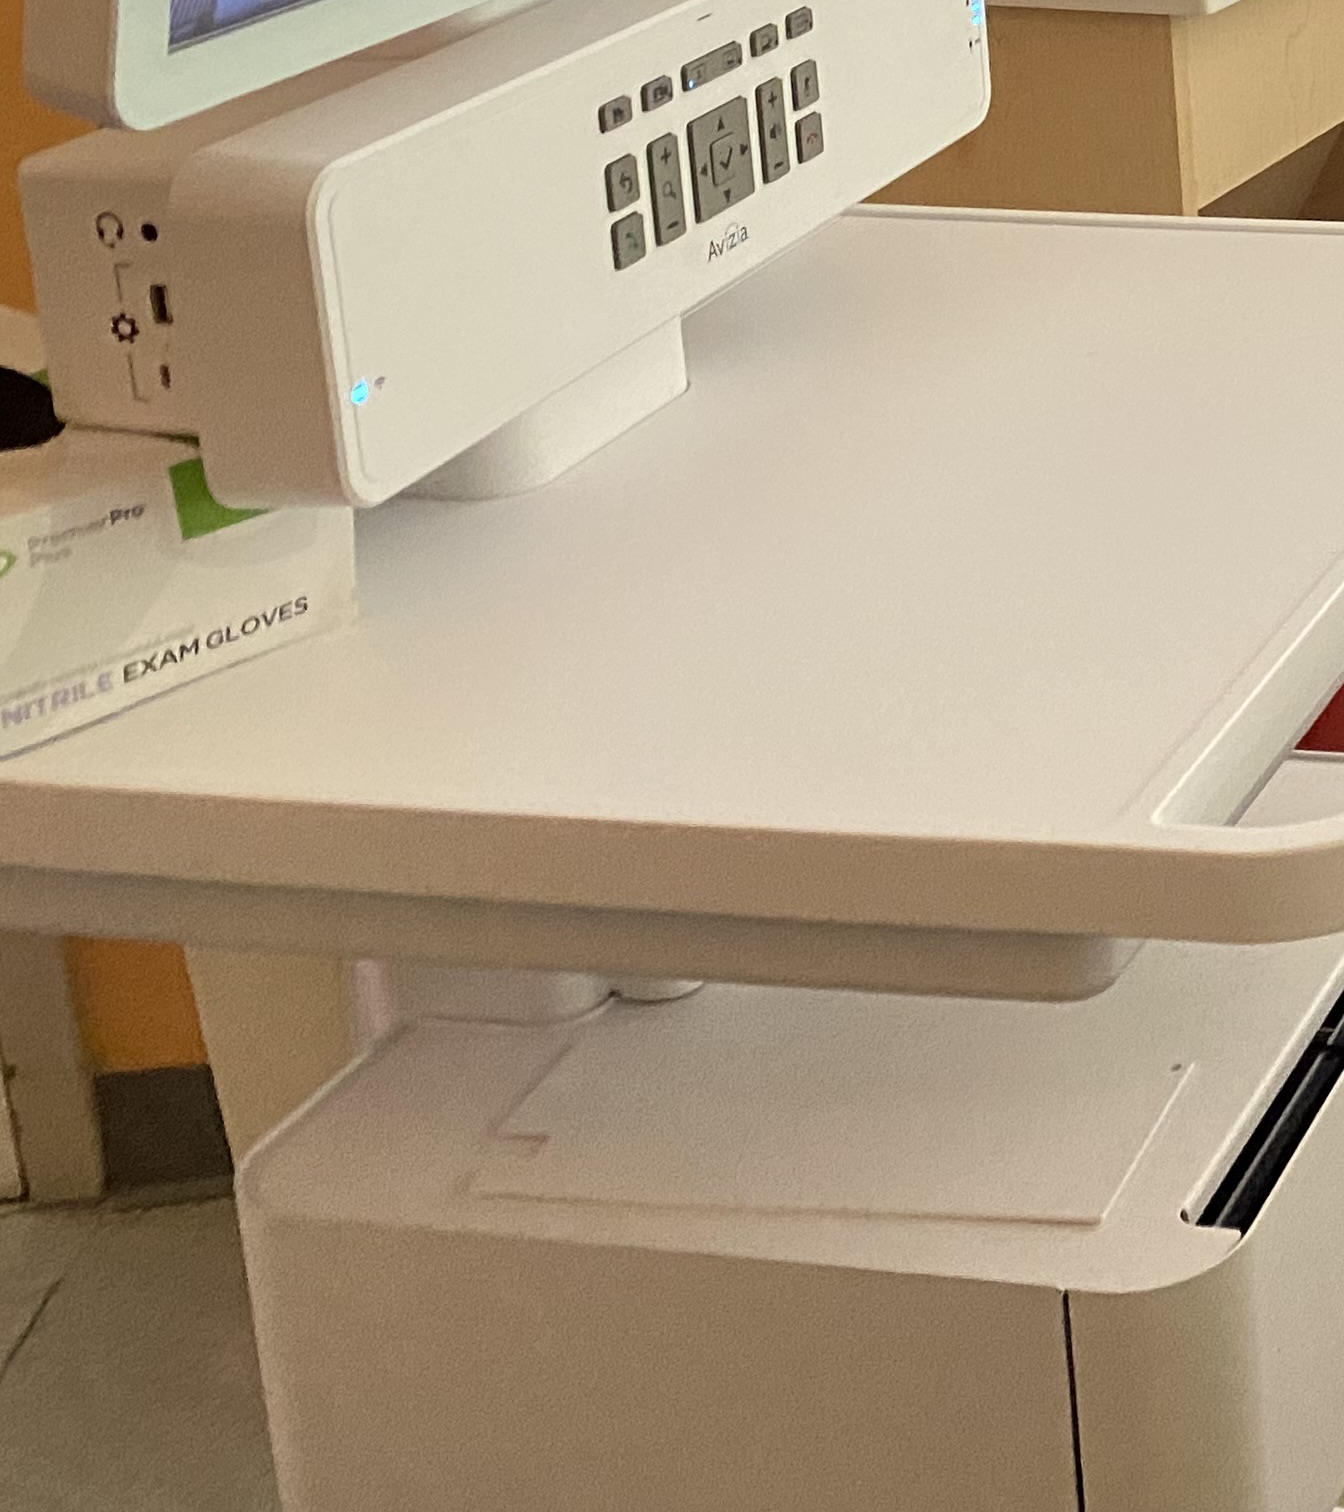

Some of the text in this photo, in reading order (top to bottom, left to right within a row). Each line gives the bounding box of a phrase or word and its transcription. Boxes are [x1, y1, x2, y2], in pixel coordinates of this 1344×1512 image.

[707, 225, 748, 263] Avizia
[2, 670, 113, 728] NITRILE
[122, 637, 201, 683] EXAM
[205, 595, 309, 650] GLOVES
